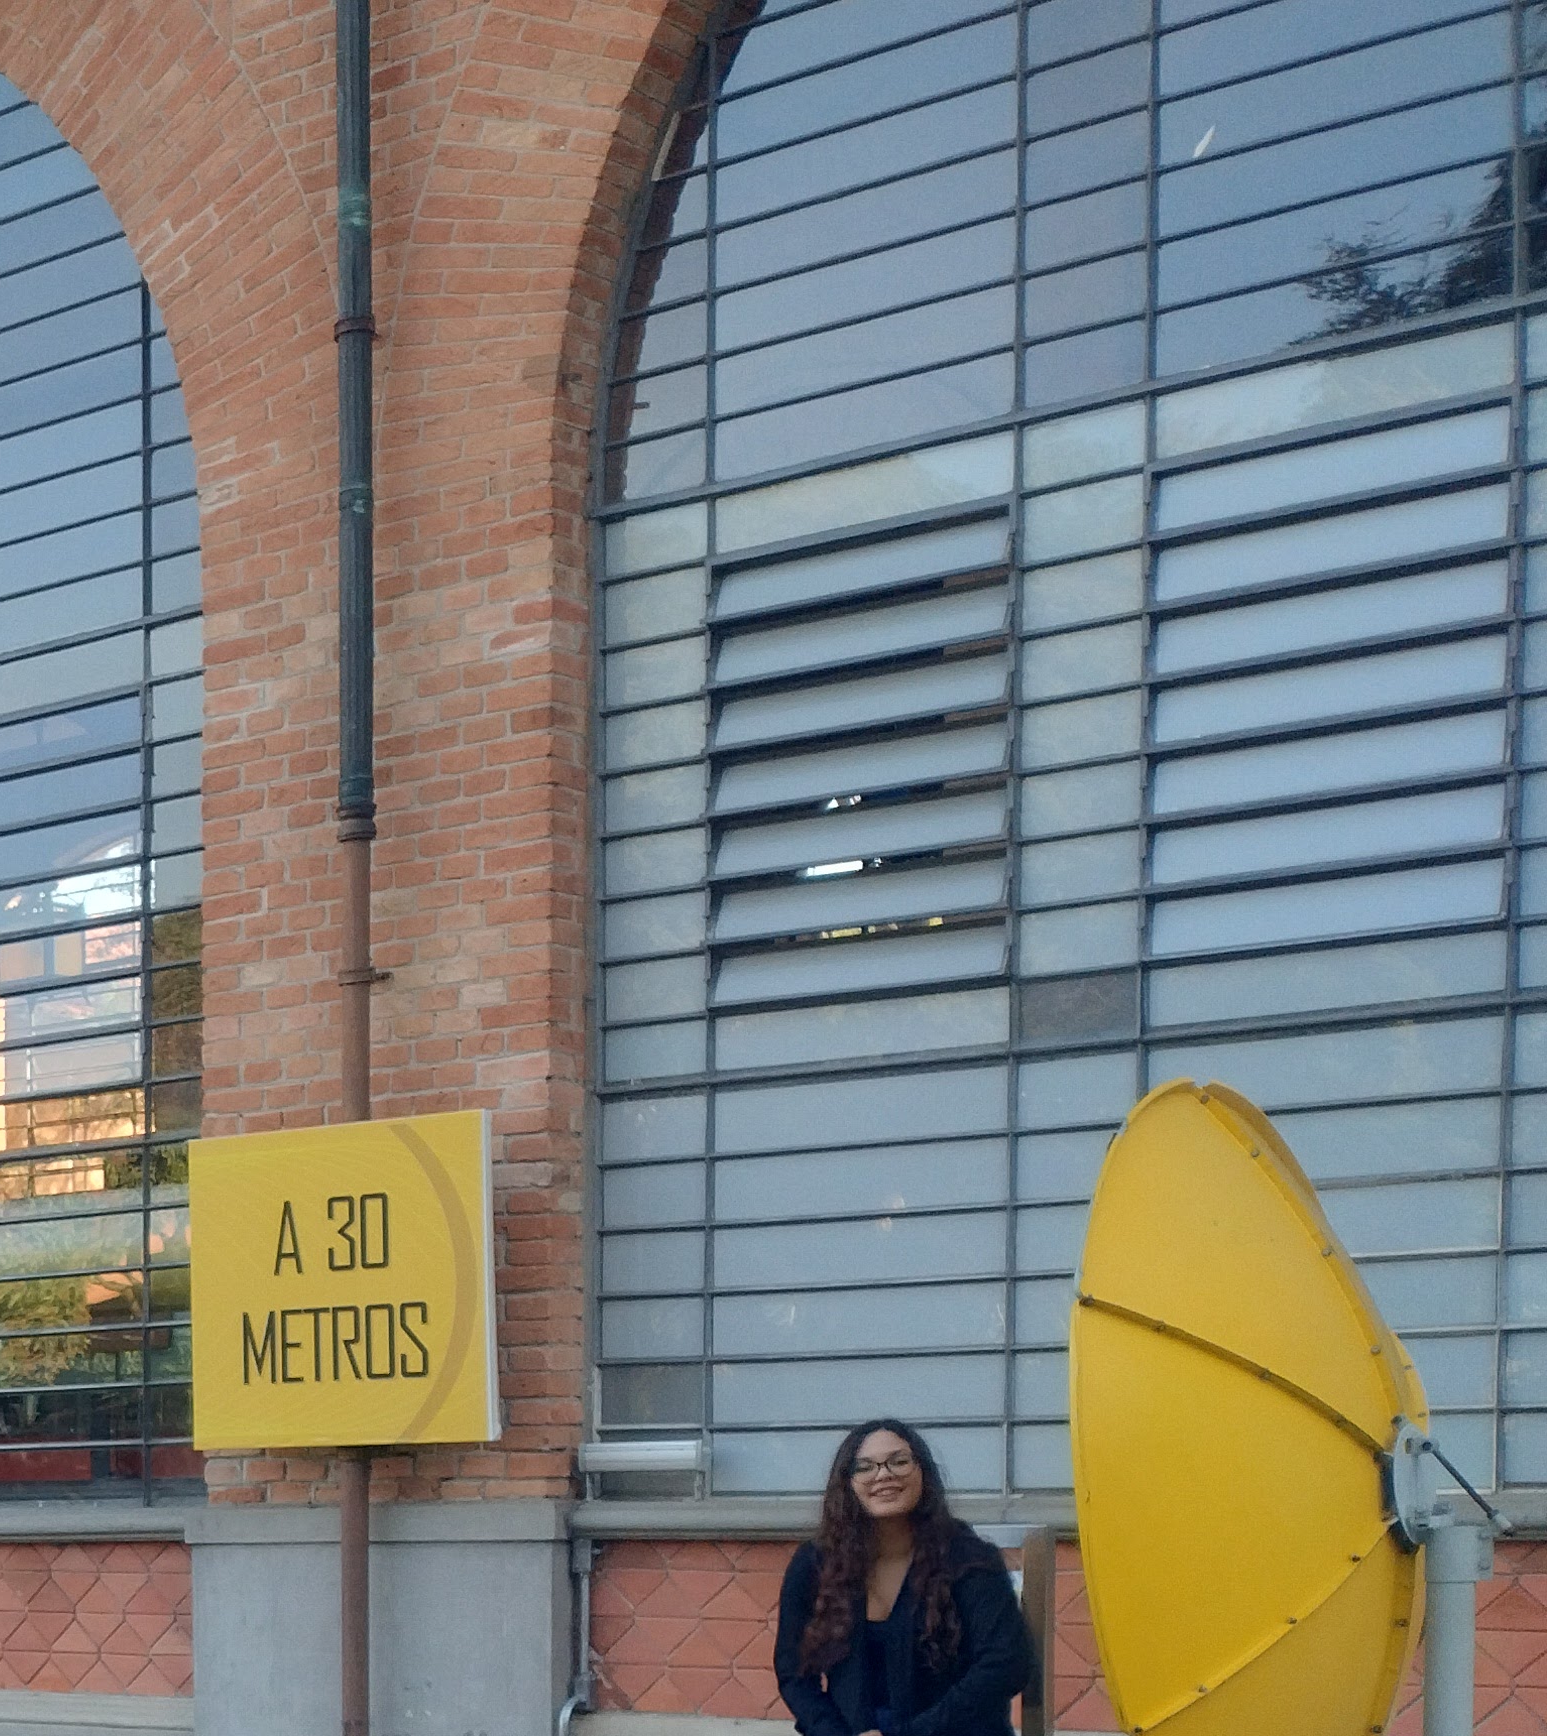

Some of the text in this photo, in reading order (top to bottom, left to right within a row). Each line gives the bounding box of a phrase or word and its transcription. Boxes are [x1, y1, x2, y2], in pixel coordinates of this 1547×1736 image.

[273, 1192, 389, 1276] A 30
[242, 1301, 429, 1384] METROS
